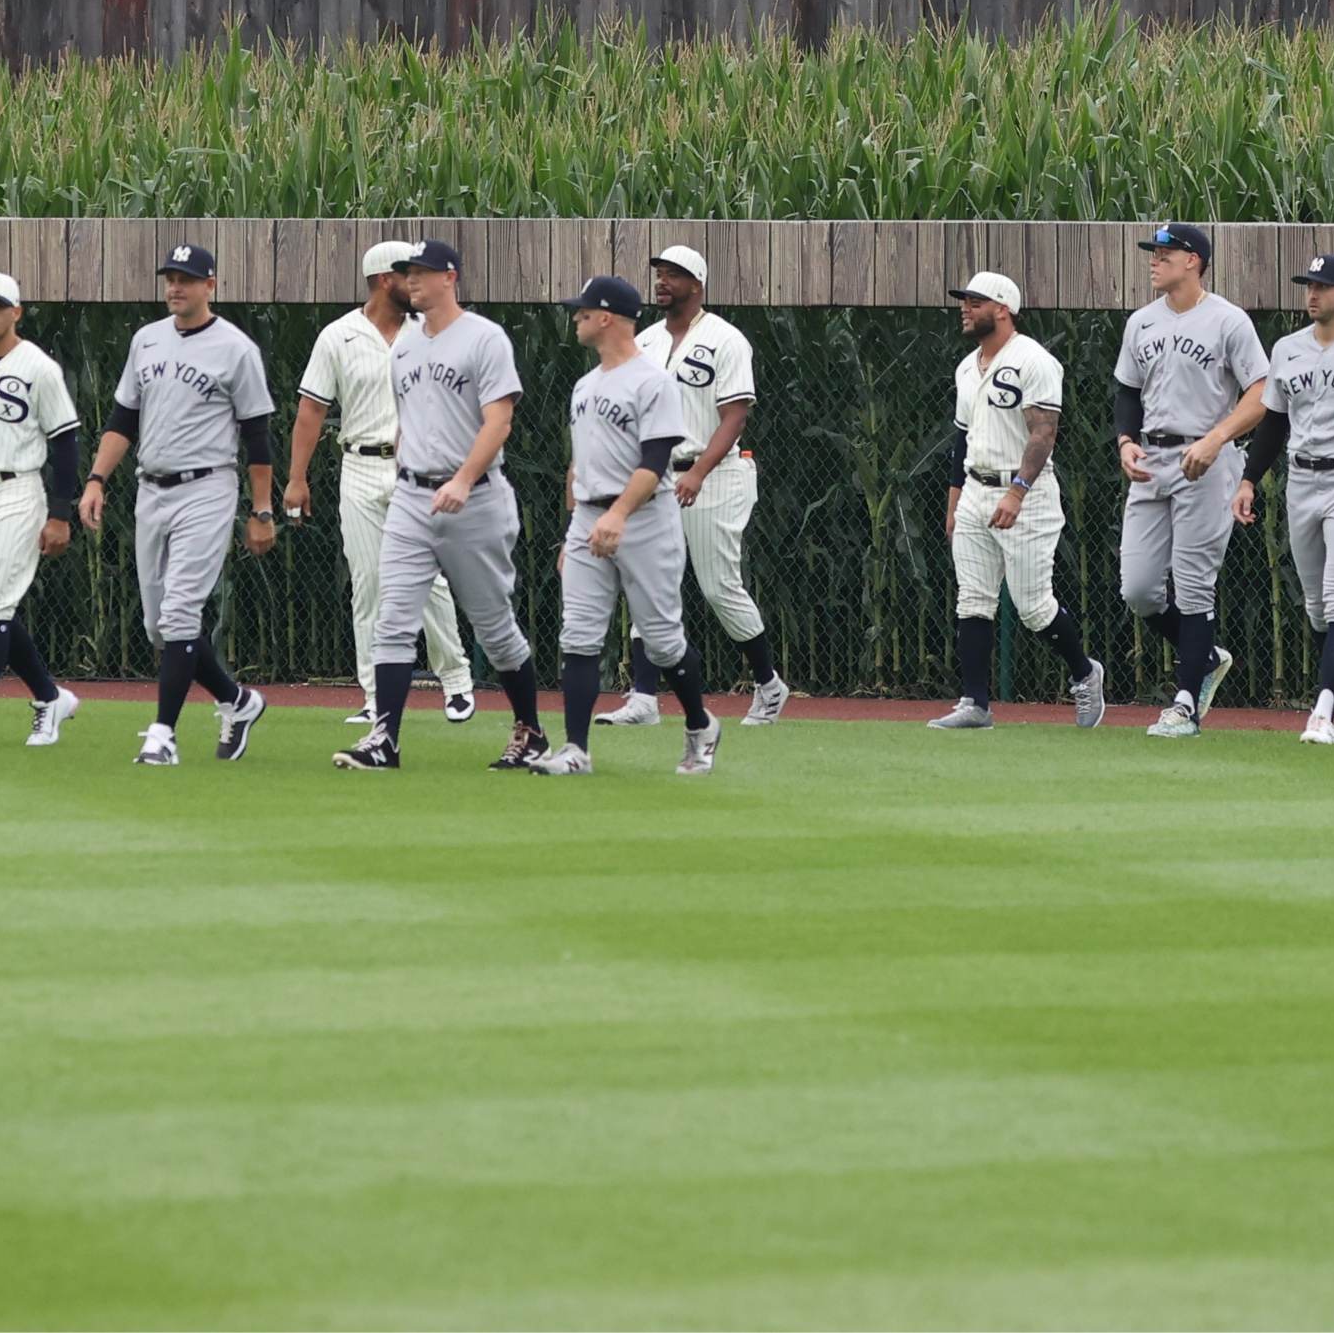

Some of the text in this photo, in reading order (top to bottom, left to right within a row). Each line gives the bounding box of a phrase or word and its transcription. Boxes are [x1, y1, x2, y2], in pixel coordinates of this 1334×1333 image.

[1173, 334, 1216, 370] YORK
[139, 361, 220, 402] EW YORK
[427, 362, 470, 395] YORK
[594, 395, 635, 432] YORK
